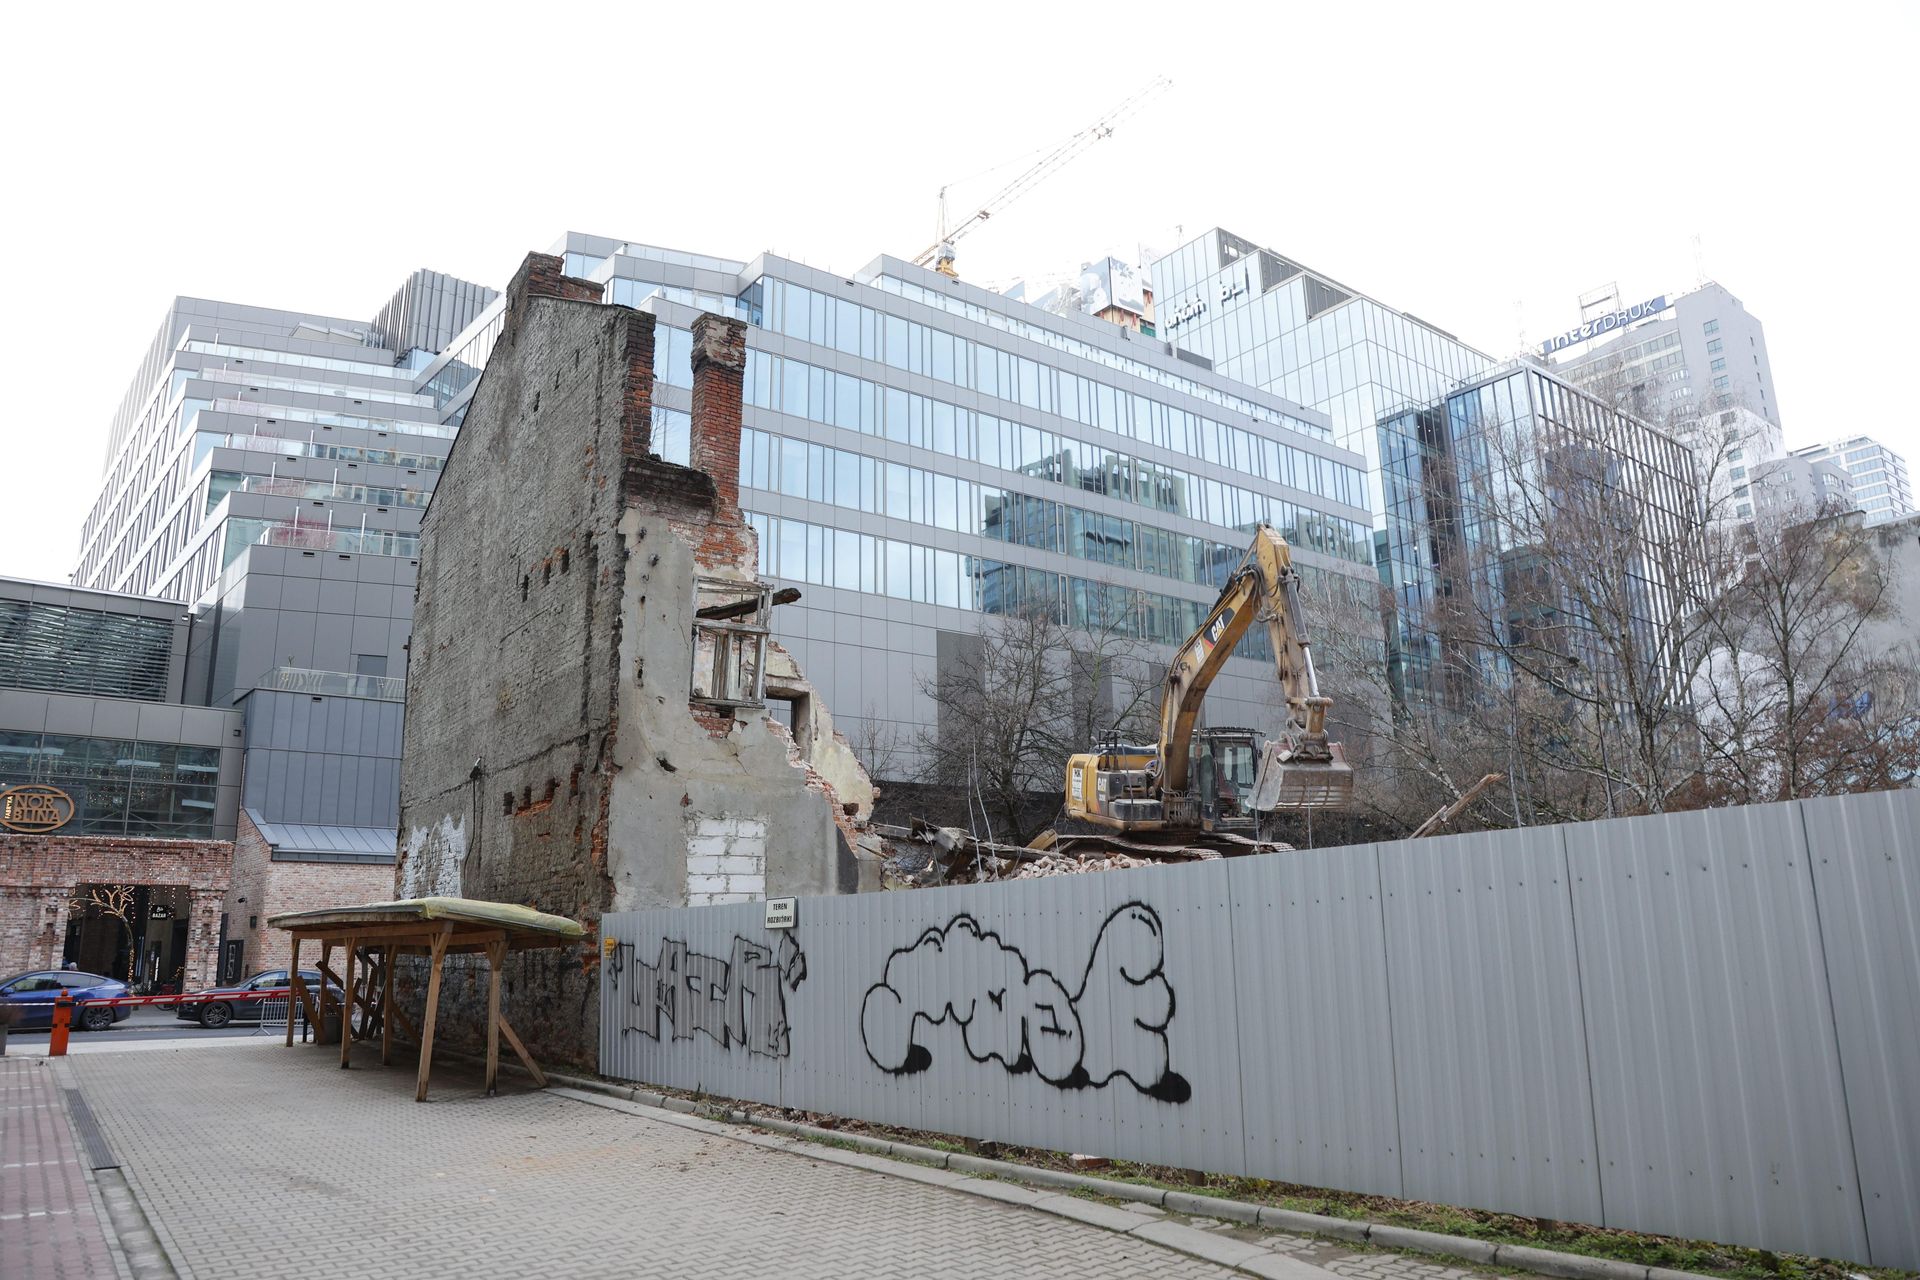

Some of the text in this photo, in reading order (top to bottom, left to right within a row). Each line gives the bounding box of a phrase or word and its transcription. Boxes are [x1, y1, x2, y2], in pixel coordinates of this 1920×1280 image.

[1211, 613, 1225, 642] CAT
[14, 793, 55, 809] NOR
[13, 808, 61, 823] BLINA
[773, 903, 788, 911] TEREN
